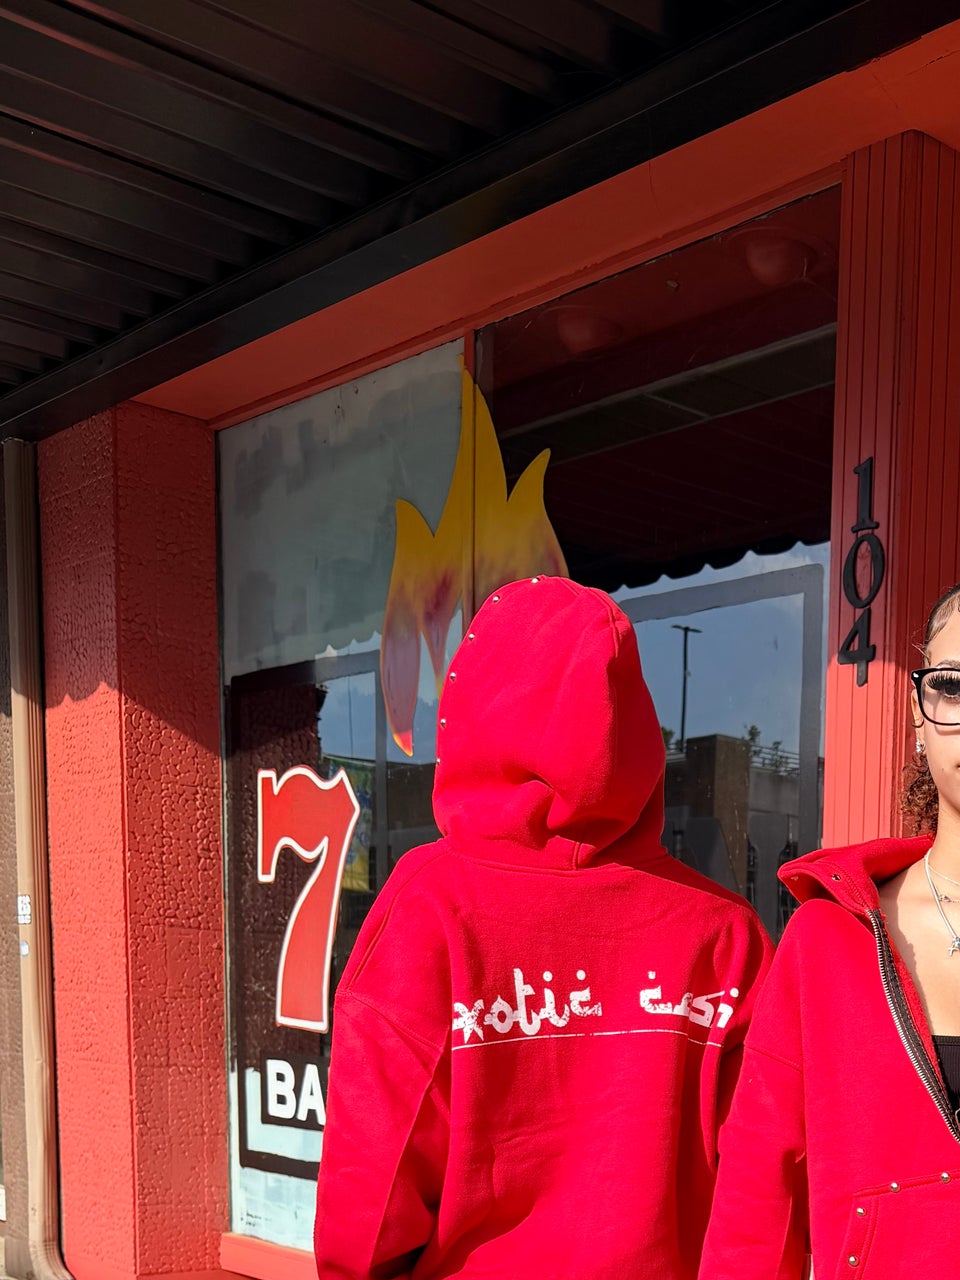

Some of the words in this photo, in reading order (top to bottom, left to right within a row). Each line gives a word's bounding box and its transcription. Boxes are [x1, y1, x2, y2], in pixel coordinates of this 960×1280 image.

[837, 456, 886, 688] 104
[257, 765, 361, 1034] 7
[451, 968, 602, 1044] xotic
[266, 1058, 327, 1122] BA
